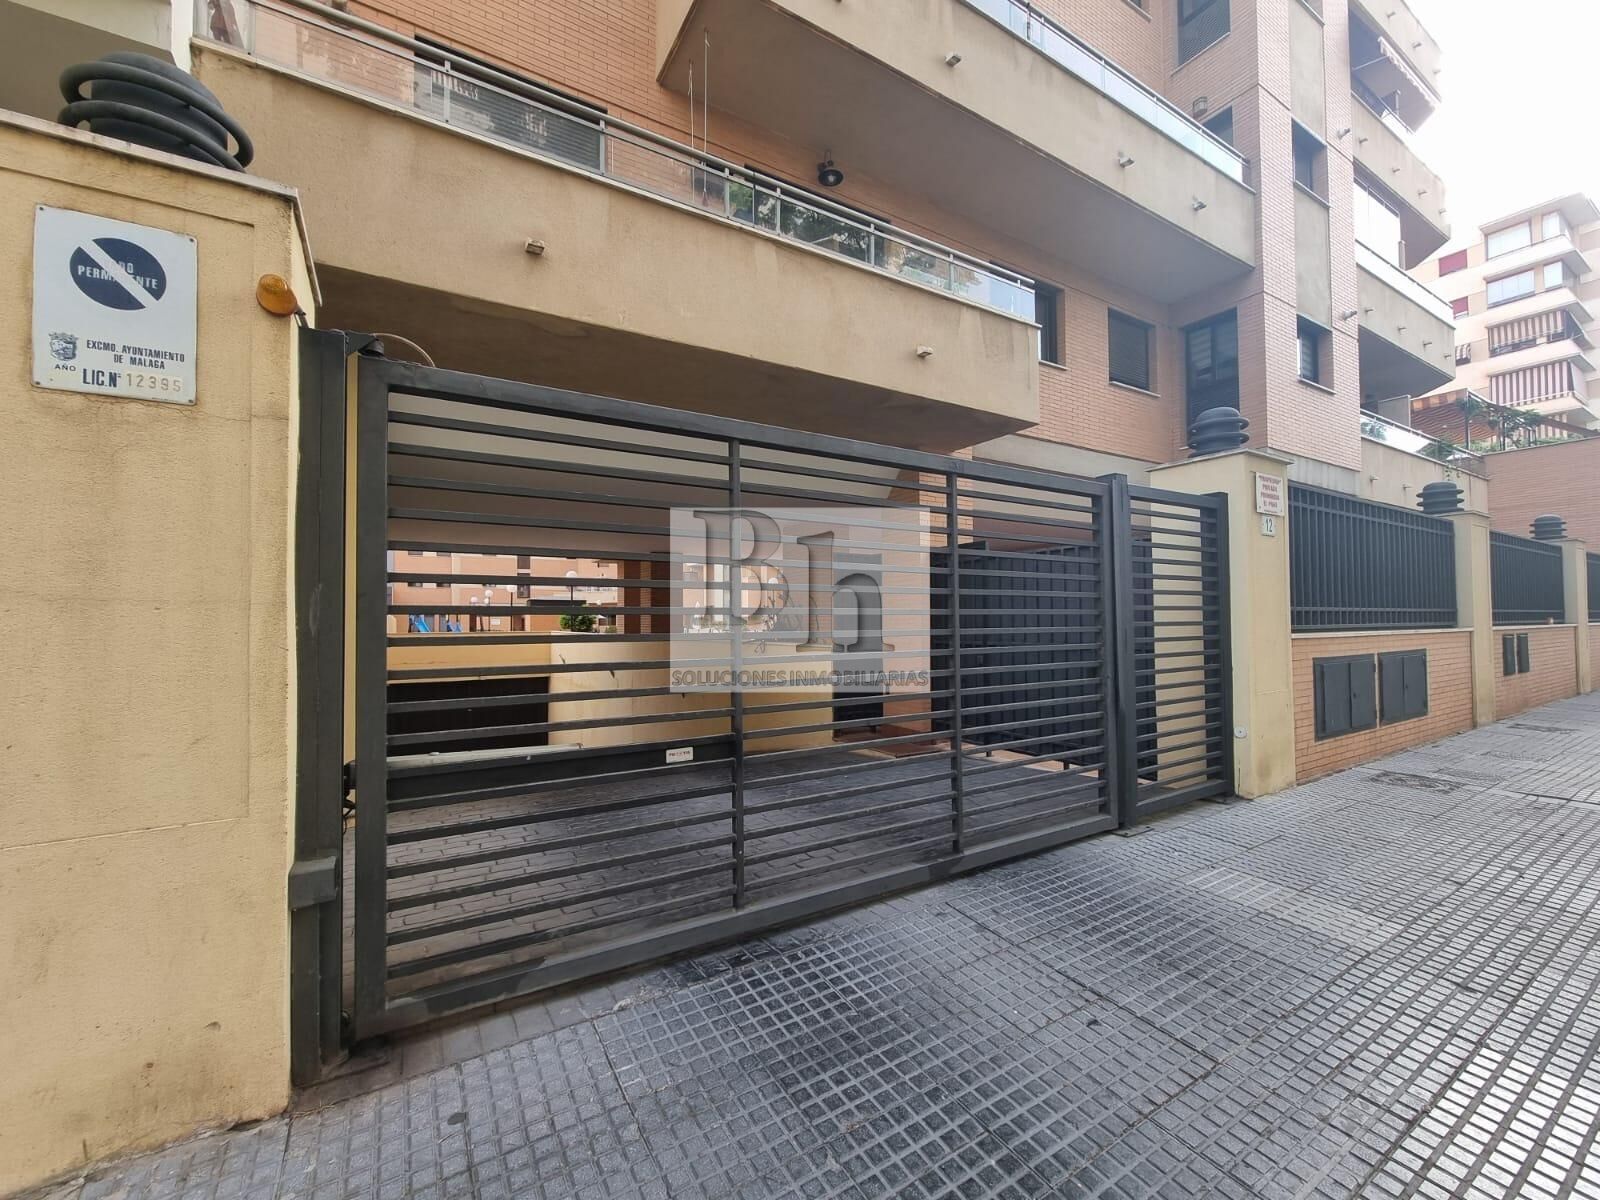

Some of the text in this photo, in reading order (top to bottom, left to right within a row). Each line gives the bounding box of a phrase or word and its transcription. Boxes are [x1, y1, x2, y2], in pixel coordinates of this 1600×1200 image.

[77, 265, 159, 289] PERMNTE
[86, 339, 185, 362] EXCMO. AYUNTAMIENTO
[54, 361, 77, 372] AÑO
[113, 353, 165, 369] DE MALAGA
[126, 373, 181, 392] 12395
[1265, 517, 1273, 533] 12
